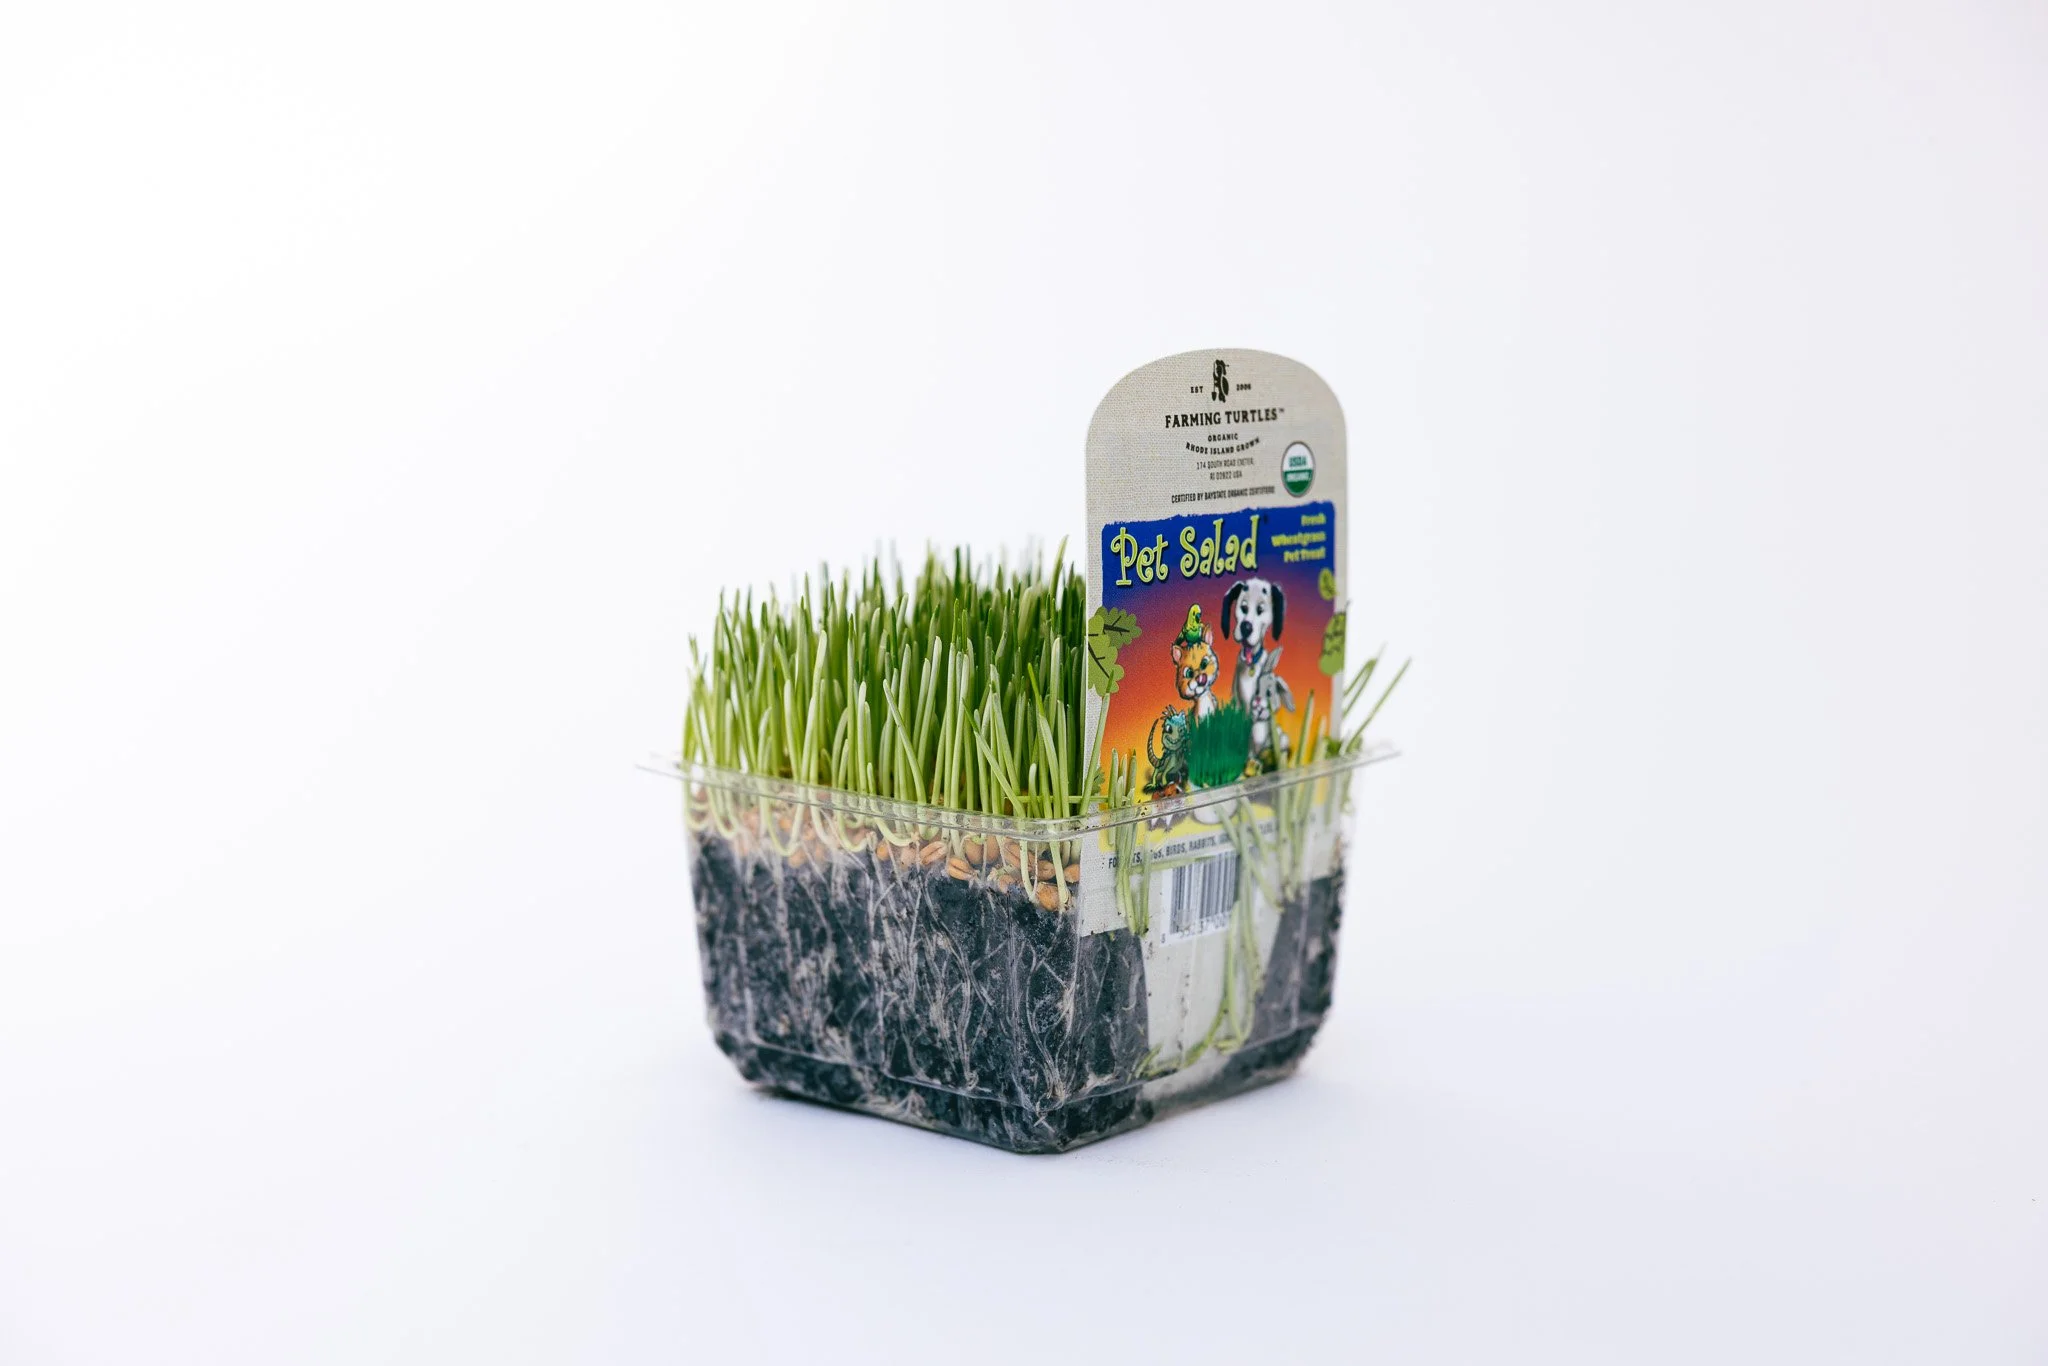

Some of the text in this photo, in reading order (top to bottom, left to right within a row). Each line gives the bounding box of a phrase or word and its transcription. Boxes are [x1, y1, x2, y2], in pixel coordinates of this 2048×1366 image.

[1190, 386, 1204, 394] EST
[1165, 412, 1221, 428] FARMING
[1208, 433, 1238, 442] ORGANIC
[1186, 436, 1260, 455] RHODE ISLAND GROWN
[1171, 493, 1196, 504] CERTIFIED
[1197, 492, 1204, 501] BY
[1110, 514, 1260, 586] Pet Salad
